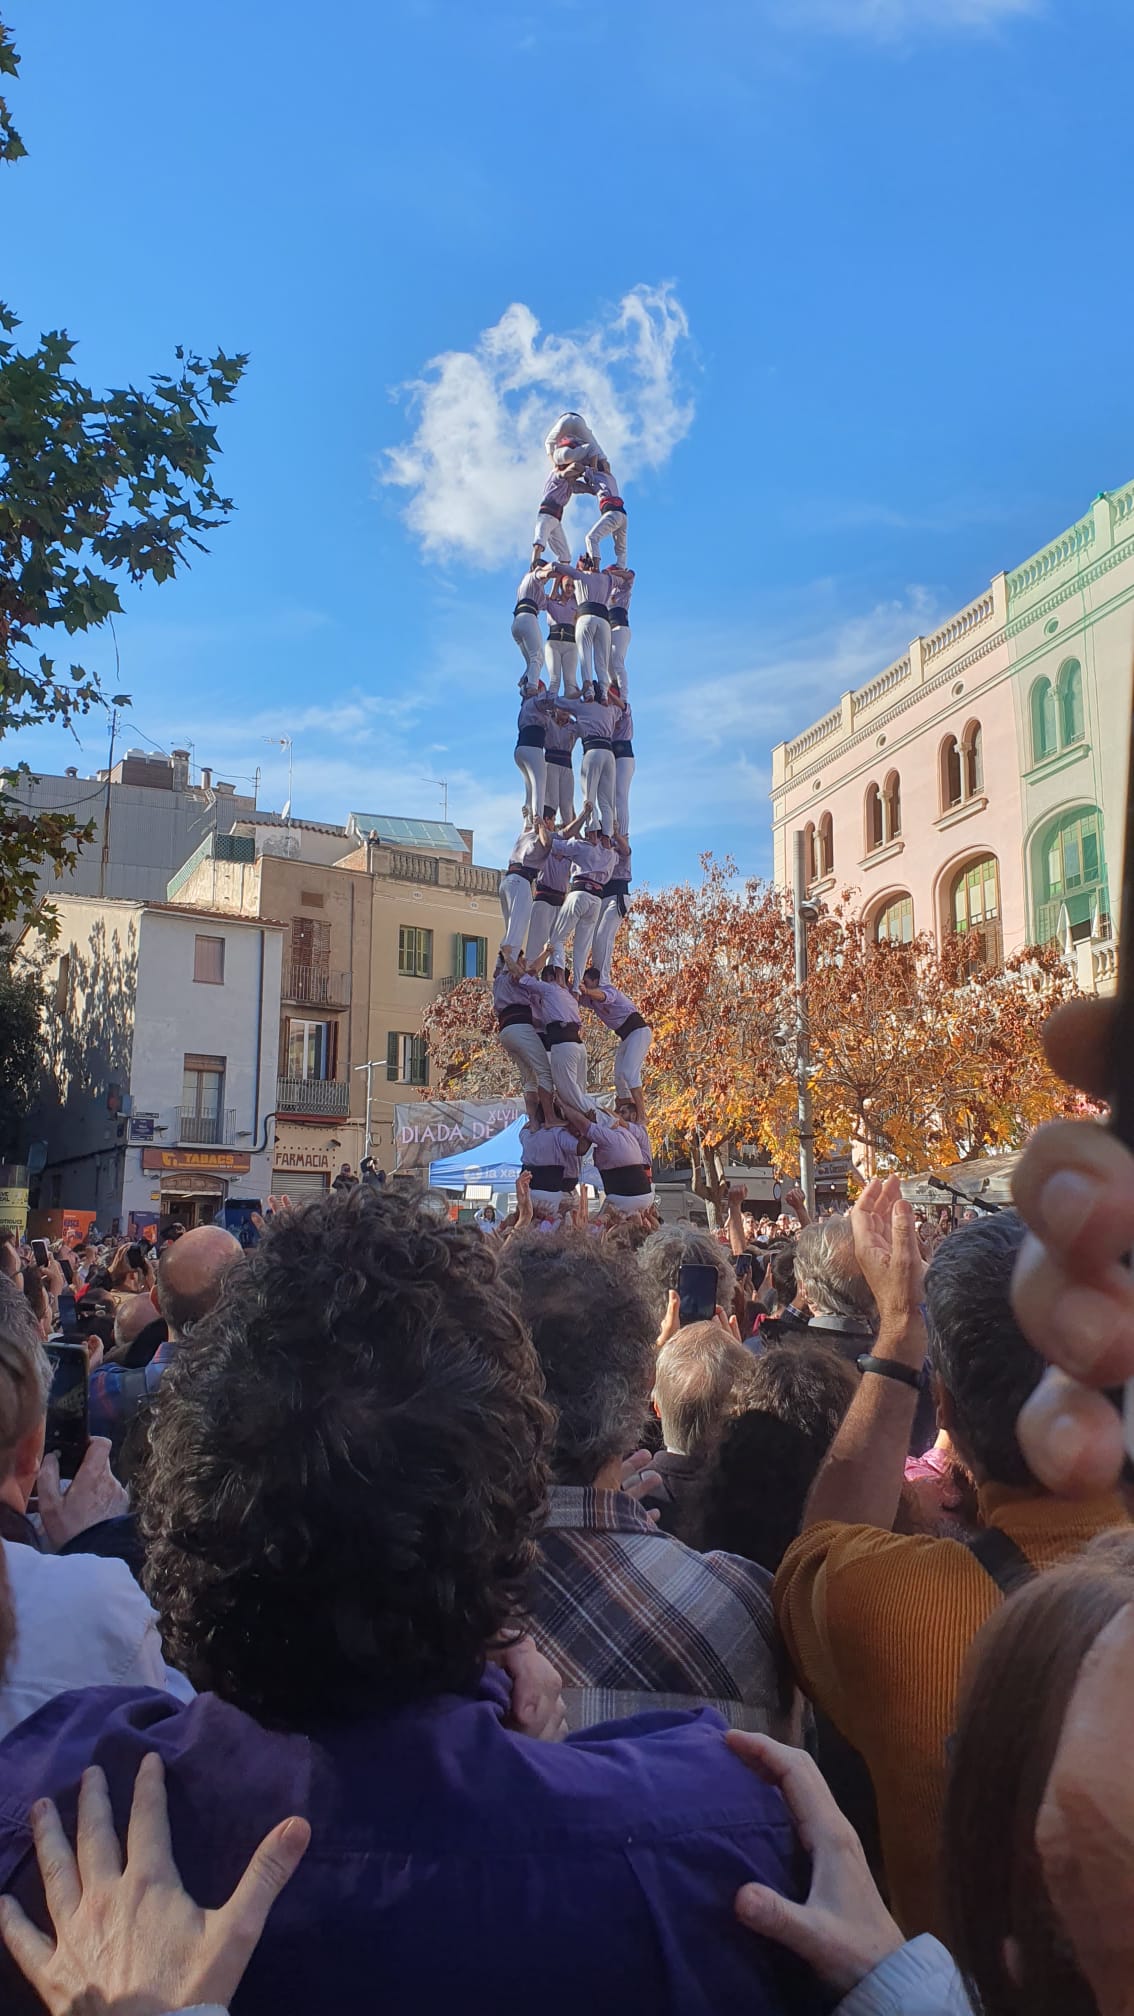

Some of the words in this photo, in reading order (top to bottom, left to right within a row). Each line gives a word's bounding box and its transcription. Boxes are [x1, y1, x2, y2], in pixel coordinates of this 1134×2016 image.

[401, 1123, 464, 1144] DIADA
[472, 1121, 496, 1140] DE
[184, 1153, 234, 1165] TABACS
[276, 1152, 328, 1168] FARMACIA
